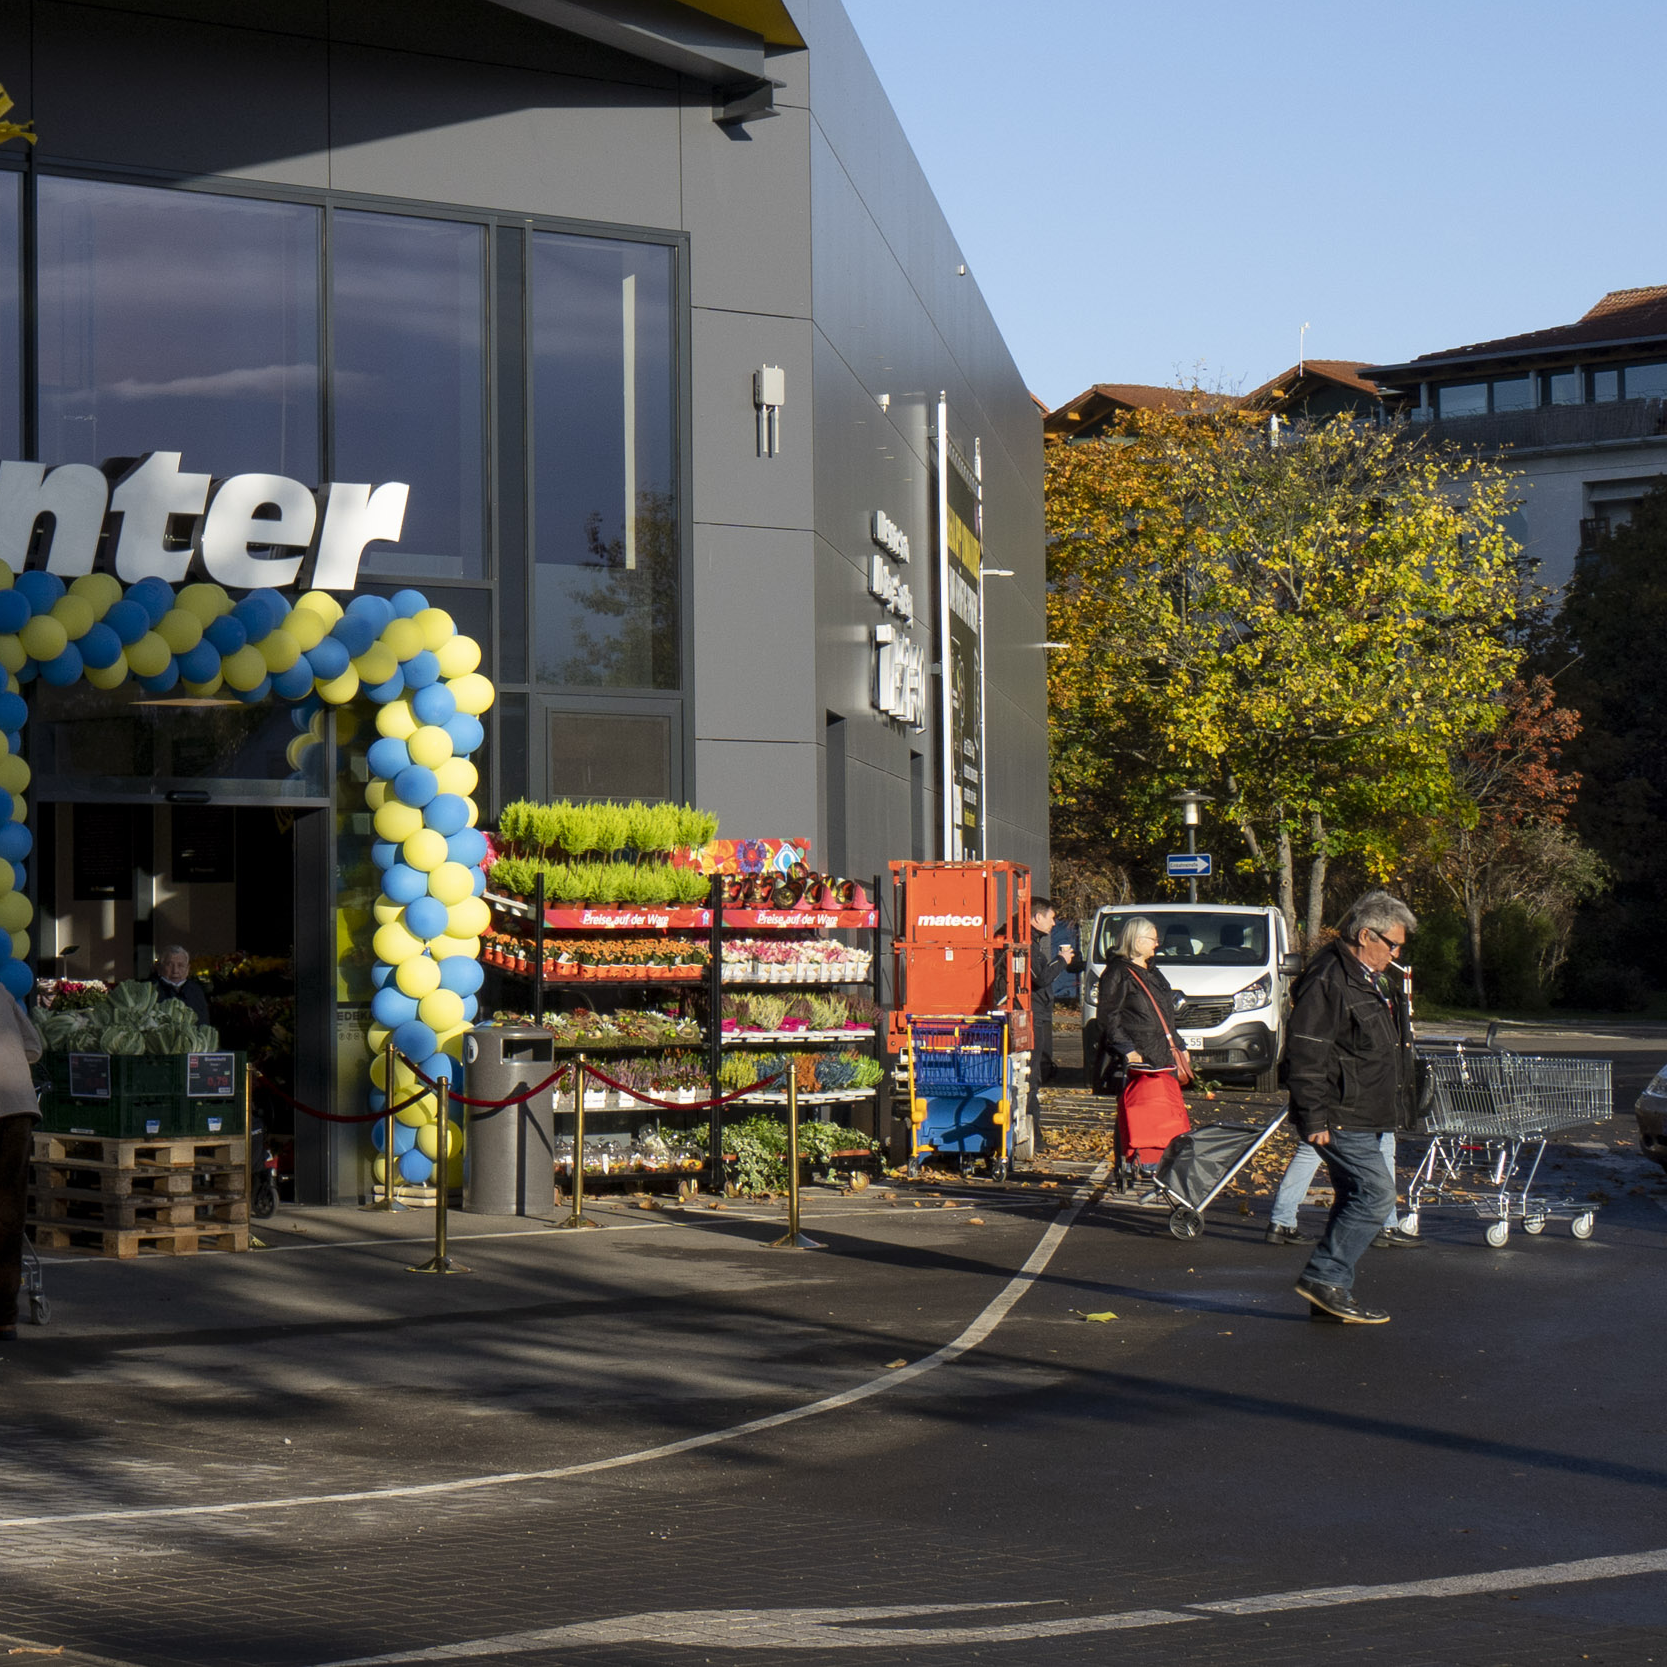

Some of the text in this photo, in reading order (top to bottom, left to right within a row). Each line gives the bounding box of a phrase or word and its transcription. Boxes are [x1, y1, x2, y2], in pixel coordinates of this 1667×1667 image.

[582, 913, 670, 926] Preise auf der Ware
[757, 913, 839, 926] Preise auf der Ware
[917, 914, 983, 927] mateco
